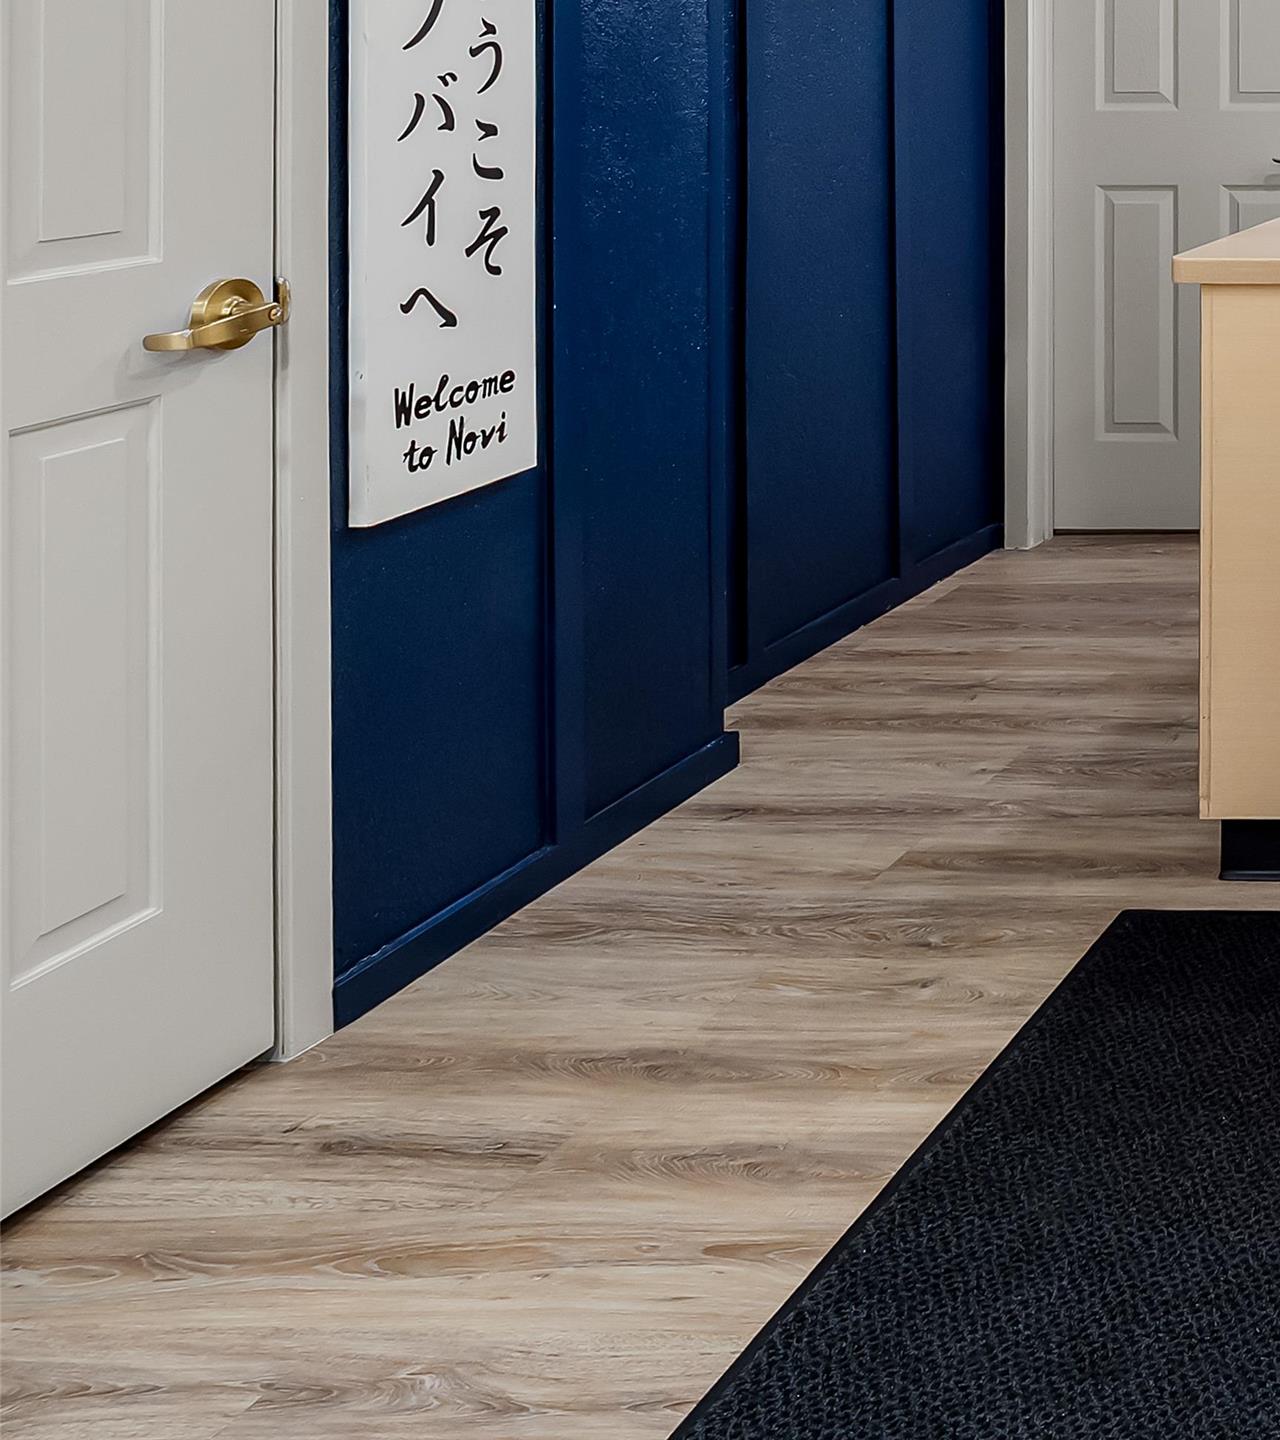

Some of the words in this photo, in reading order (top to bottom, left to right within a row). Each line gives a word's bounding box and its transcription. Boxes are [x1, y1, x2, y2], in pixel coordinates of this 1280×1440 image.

[394, 370, 516, 429] Welcome
[402, 439, 438, 473] to
[445, 411, 508, 466] Novi
